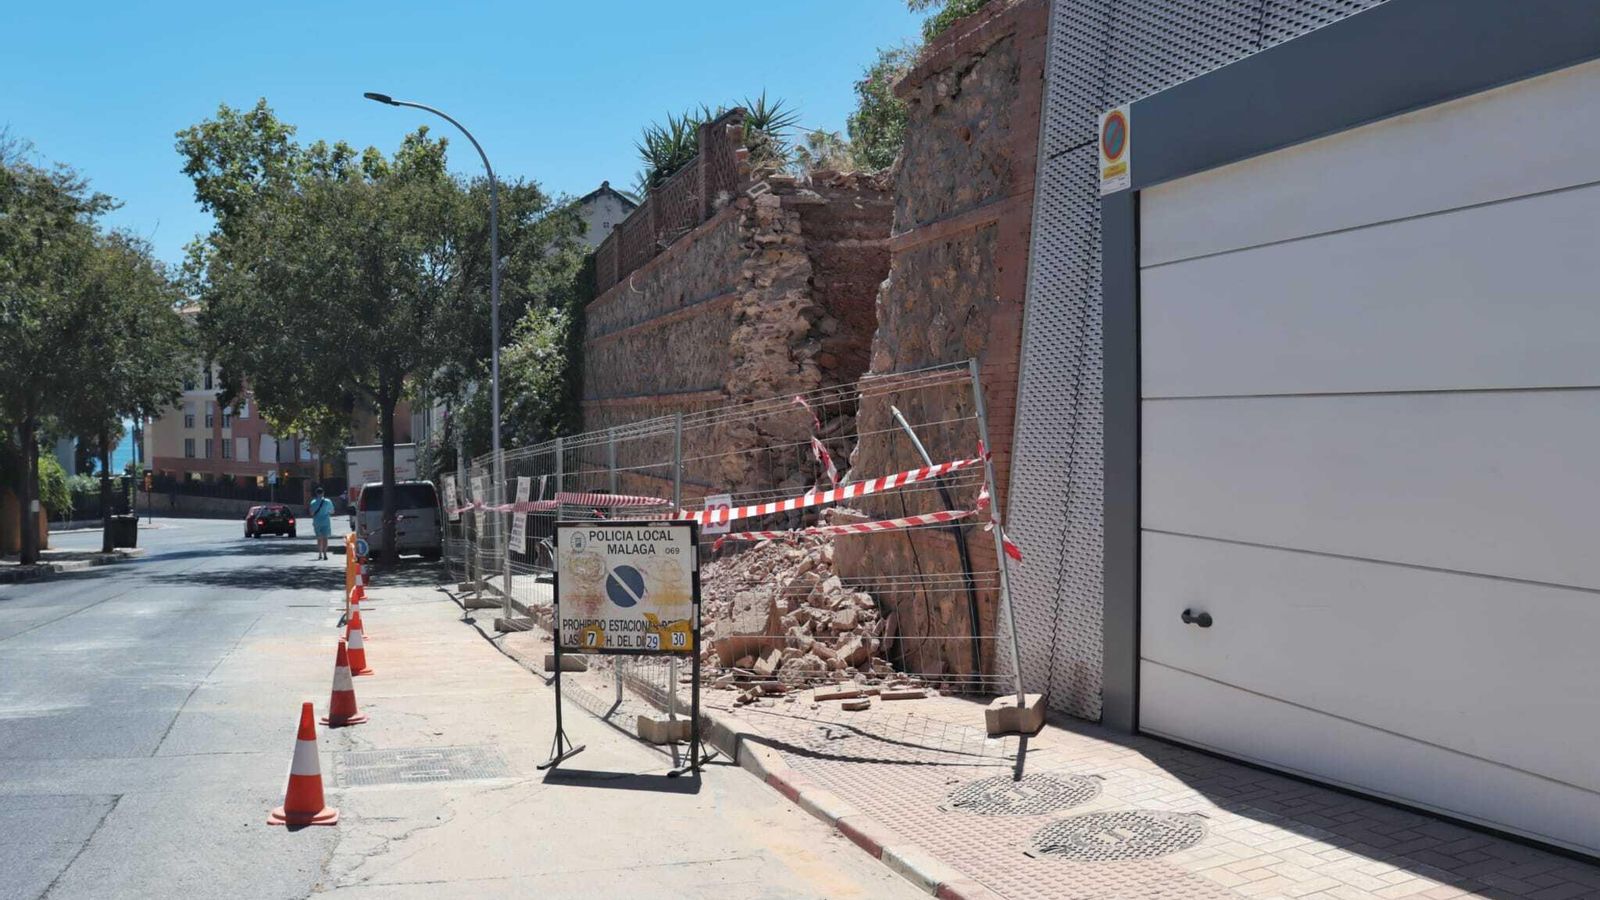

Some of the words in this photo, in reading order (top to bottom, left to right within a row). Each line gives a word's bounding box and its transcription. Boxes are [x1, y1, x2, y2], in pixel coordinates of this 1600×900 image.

[589, 530, 634, 541] POLICIA
[637, 530, 674, 541] LOCAL
[607, 543, 656, 554] MALAGA
[588, 633, 596, 646] 7
[617, 635, 633, 647] DEL
[646, 635, 658, 648] 29
[673, 632, 685, 646] 30
